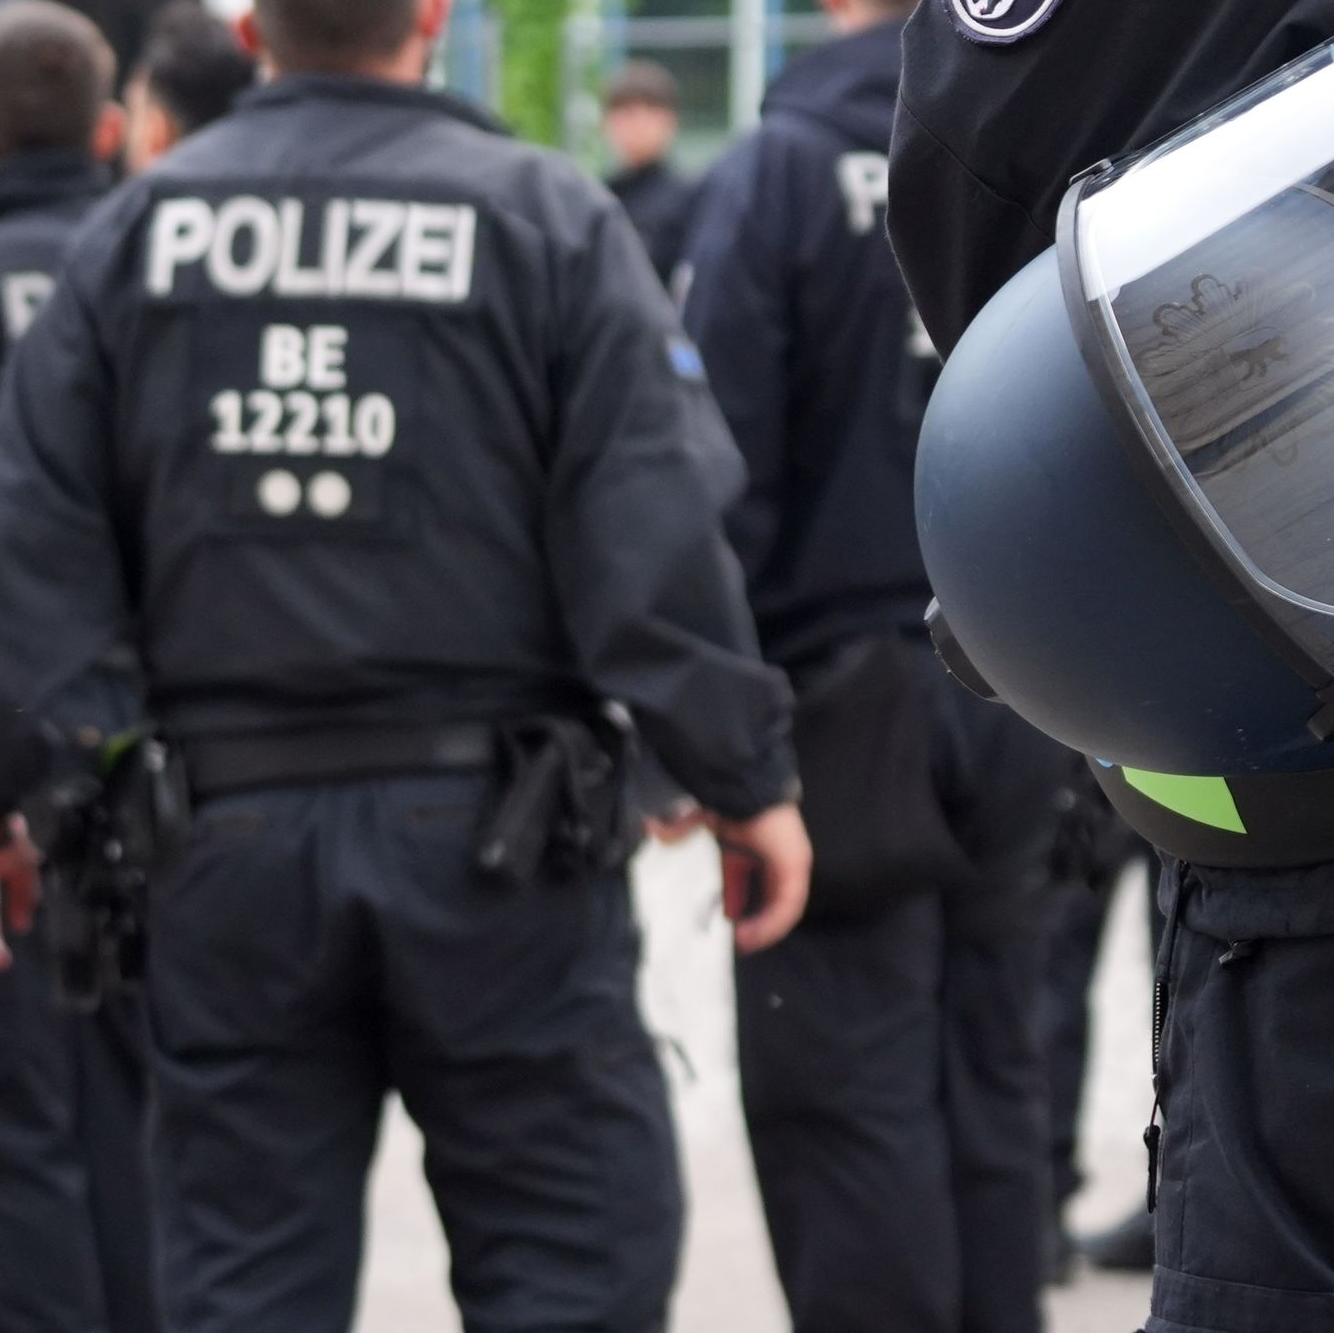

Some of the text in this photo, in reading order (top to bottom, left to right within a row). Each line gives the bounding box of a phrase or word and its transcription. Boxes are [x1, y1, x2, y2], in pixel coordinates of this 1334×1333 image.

[147, 195, 478, 304] POLIZEI
[259, 323, 348, 390] BE
[210, 388, 397, 459] 12210
